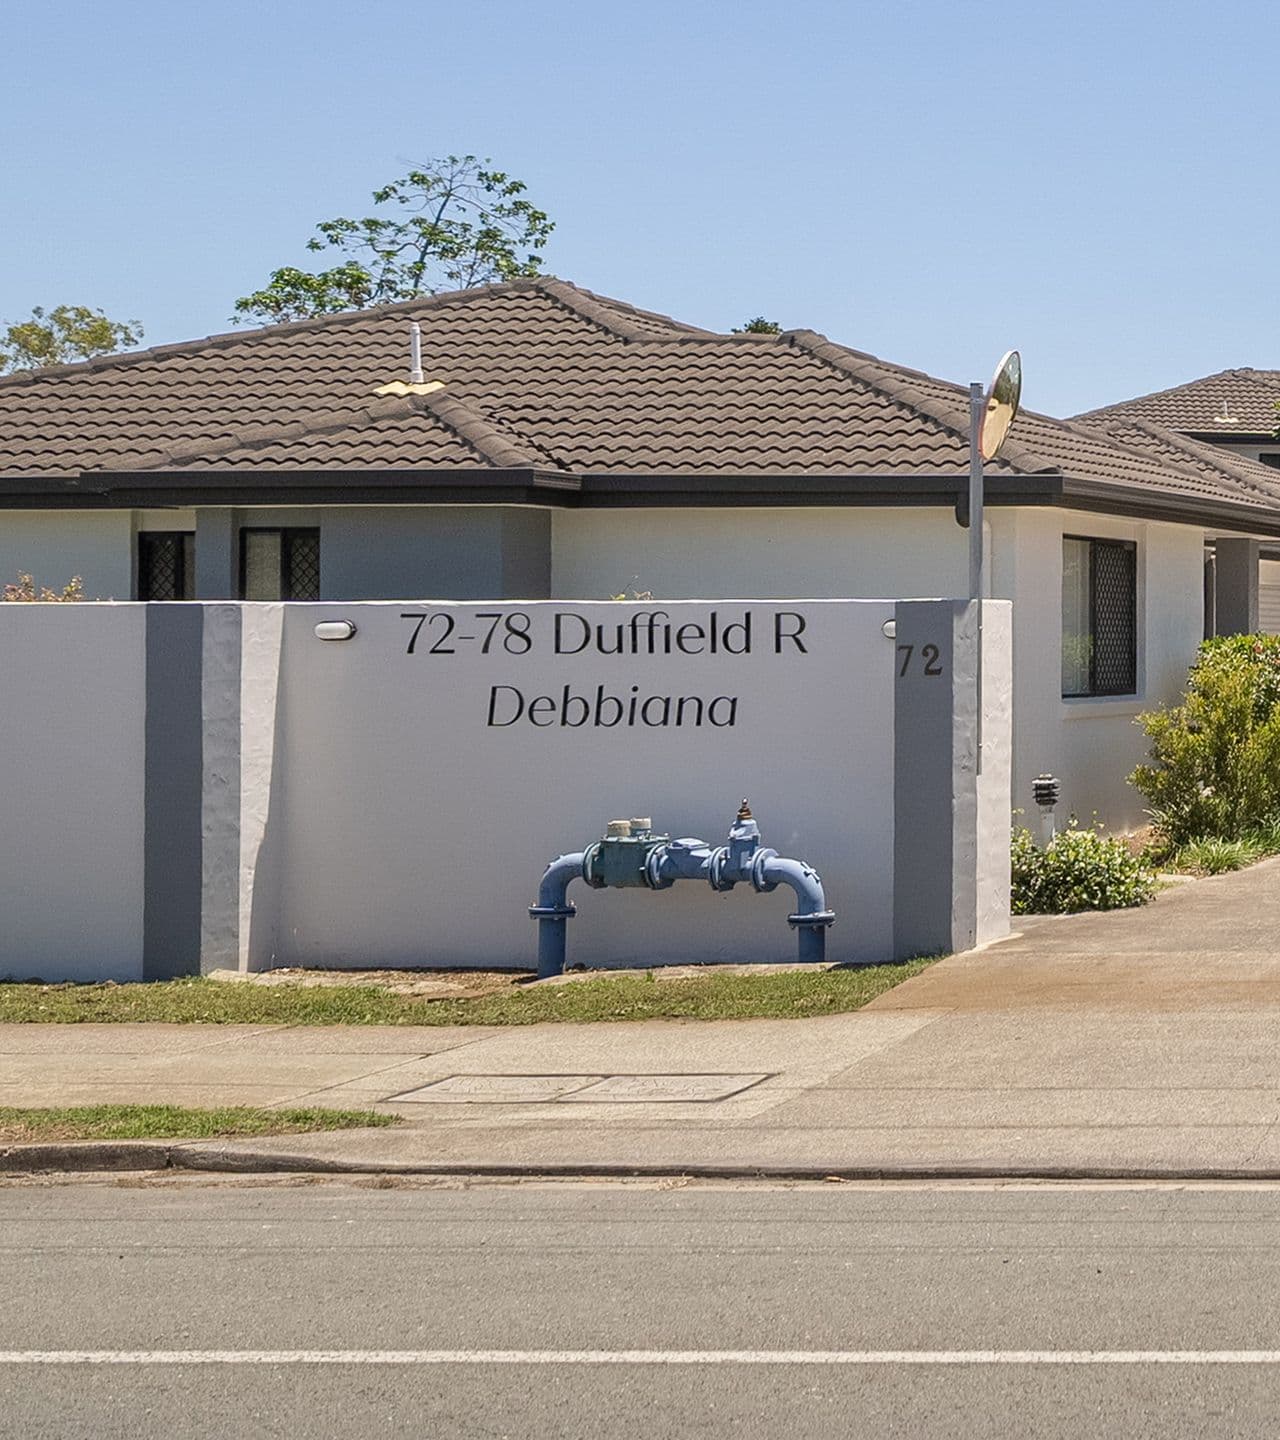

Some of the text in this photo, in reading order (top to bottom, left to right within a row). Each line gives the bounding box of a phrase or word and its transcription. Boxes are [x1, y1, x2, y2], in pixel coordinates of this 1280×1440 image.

[400, 611, 808, 654] 72-78 Duffield R
[897, 643, 943, 677] 72
[487, 684, 738, 727] Debbiana
